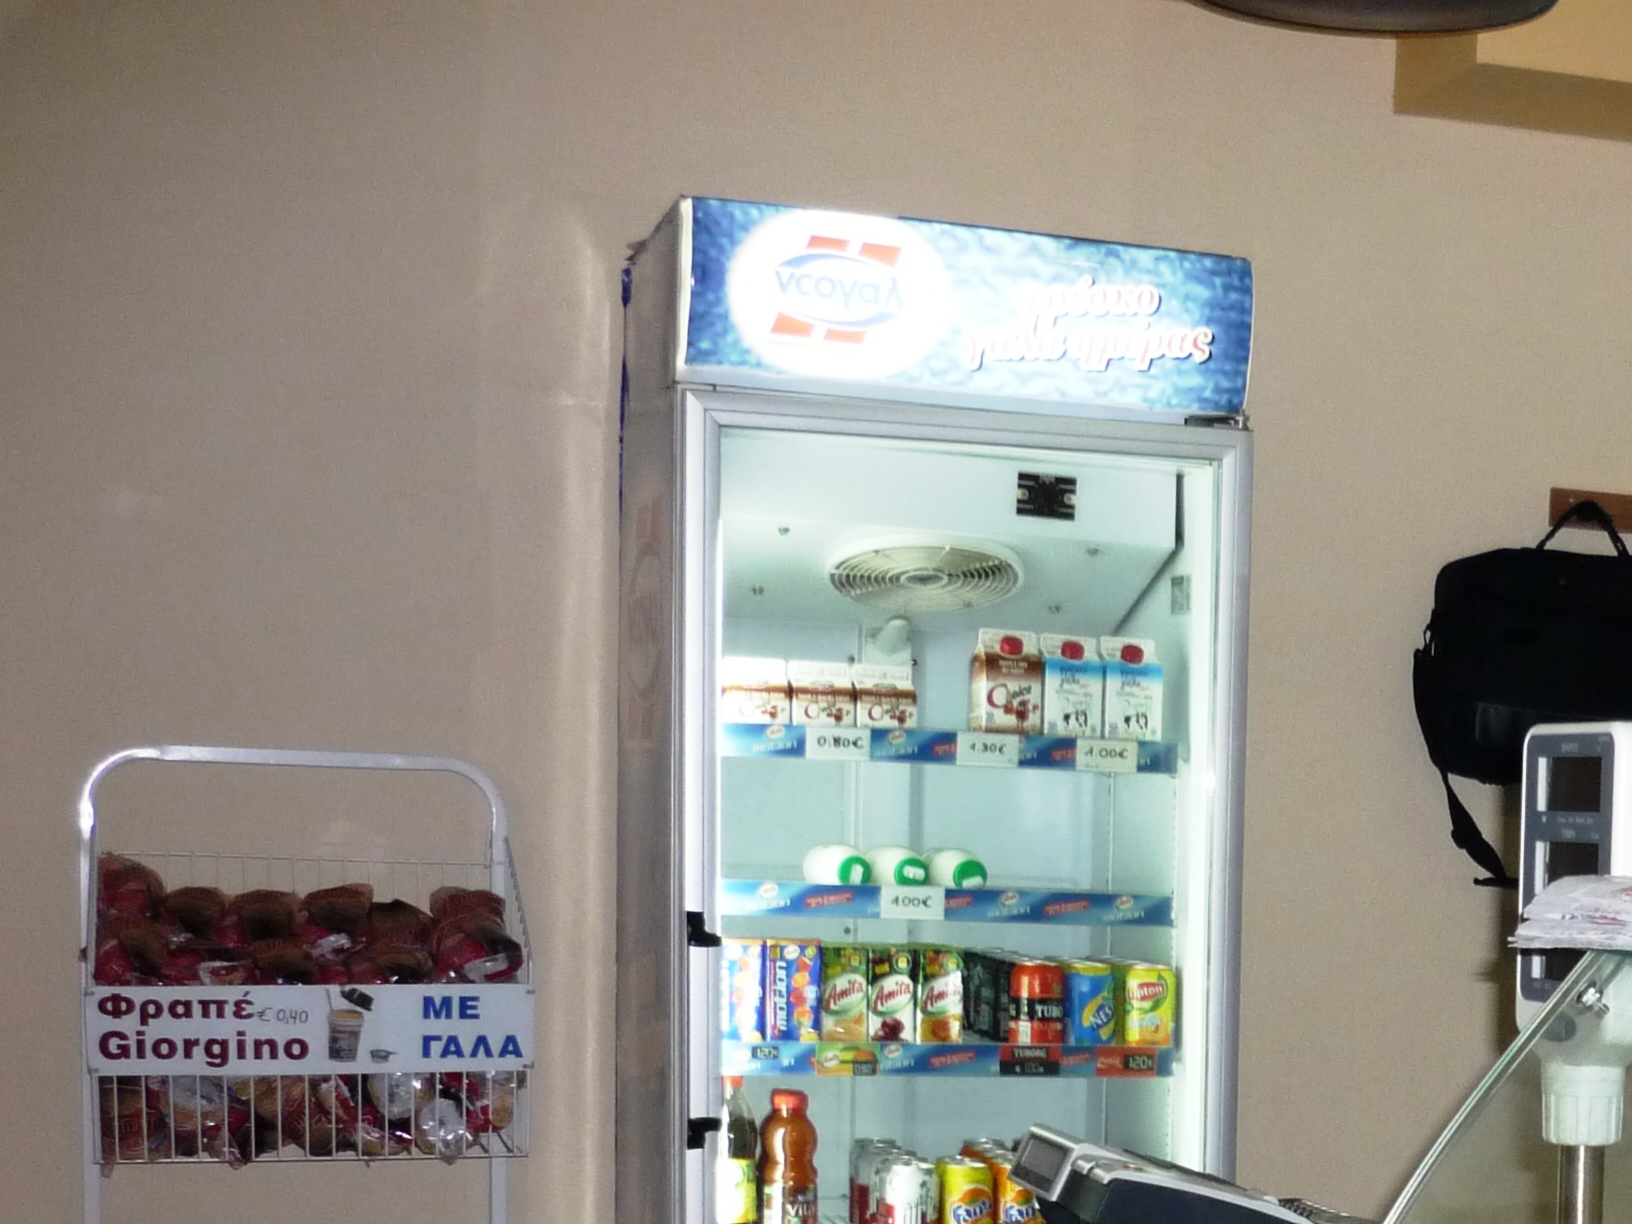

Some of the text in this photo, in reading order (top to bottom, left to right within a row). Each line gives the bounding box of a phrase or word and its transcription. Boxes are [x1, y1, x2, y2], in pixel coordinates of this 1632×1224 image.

[97, 990, 256, 1027] Φραπέ
[422, 995, 482, 1021] ΜΕ
[825, 978, 864, 1013] Amita
[872, 980, 912, 1013] Amita
[98, 1030, 310, 1068] Giorgino
[421, 1033, 524, 1060] ΓΑΛΑ
